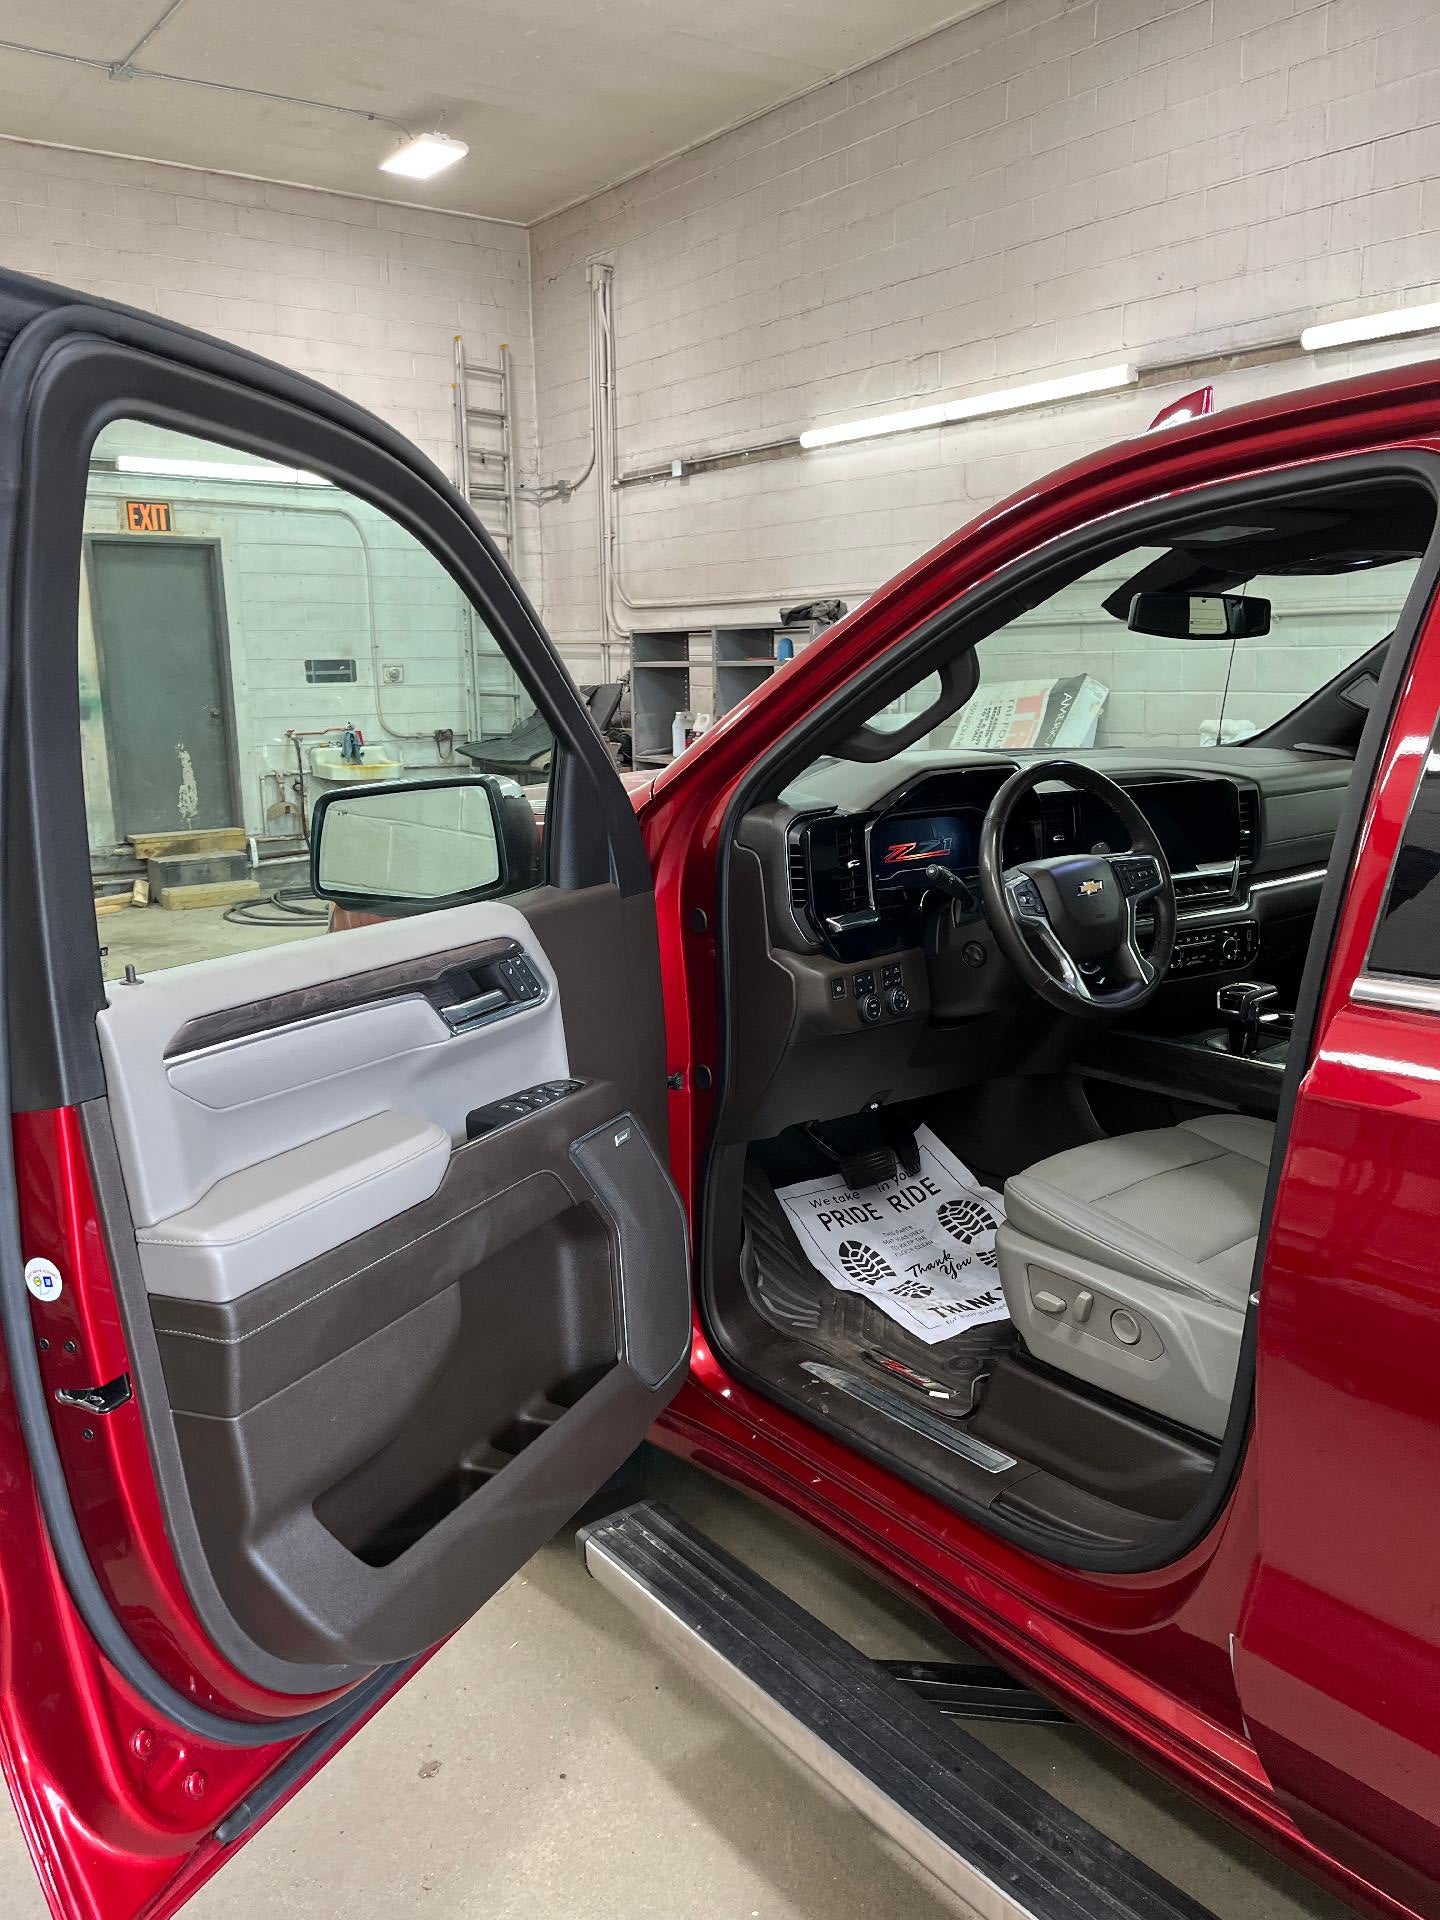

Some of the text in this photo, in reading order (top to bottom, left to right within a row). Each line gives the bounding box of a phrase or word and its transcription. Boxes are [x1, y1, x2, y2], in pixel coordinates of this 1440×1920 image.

[128, 502, 168, 531] EXIT
[884, 838, 952, 863] Z71
[808, 1170, 914, 1209] We take in you
[816, 1176, 942, 1232] PRIDE RIDE
[904, 1249, 955, 1278] Thank
[939, 1257, 972, 1280] You
[927, 1291, 1003, 1318] THANK
